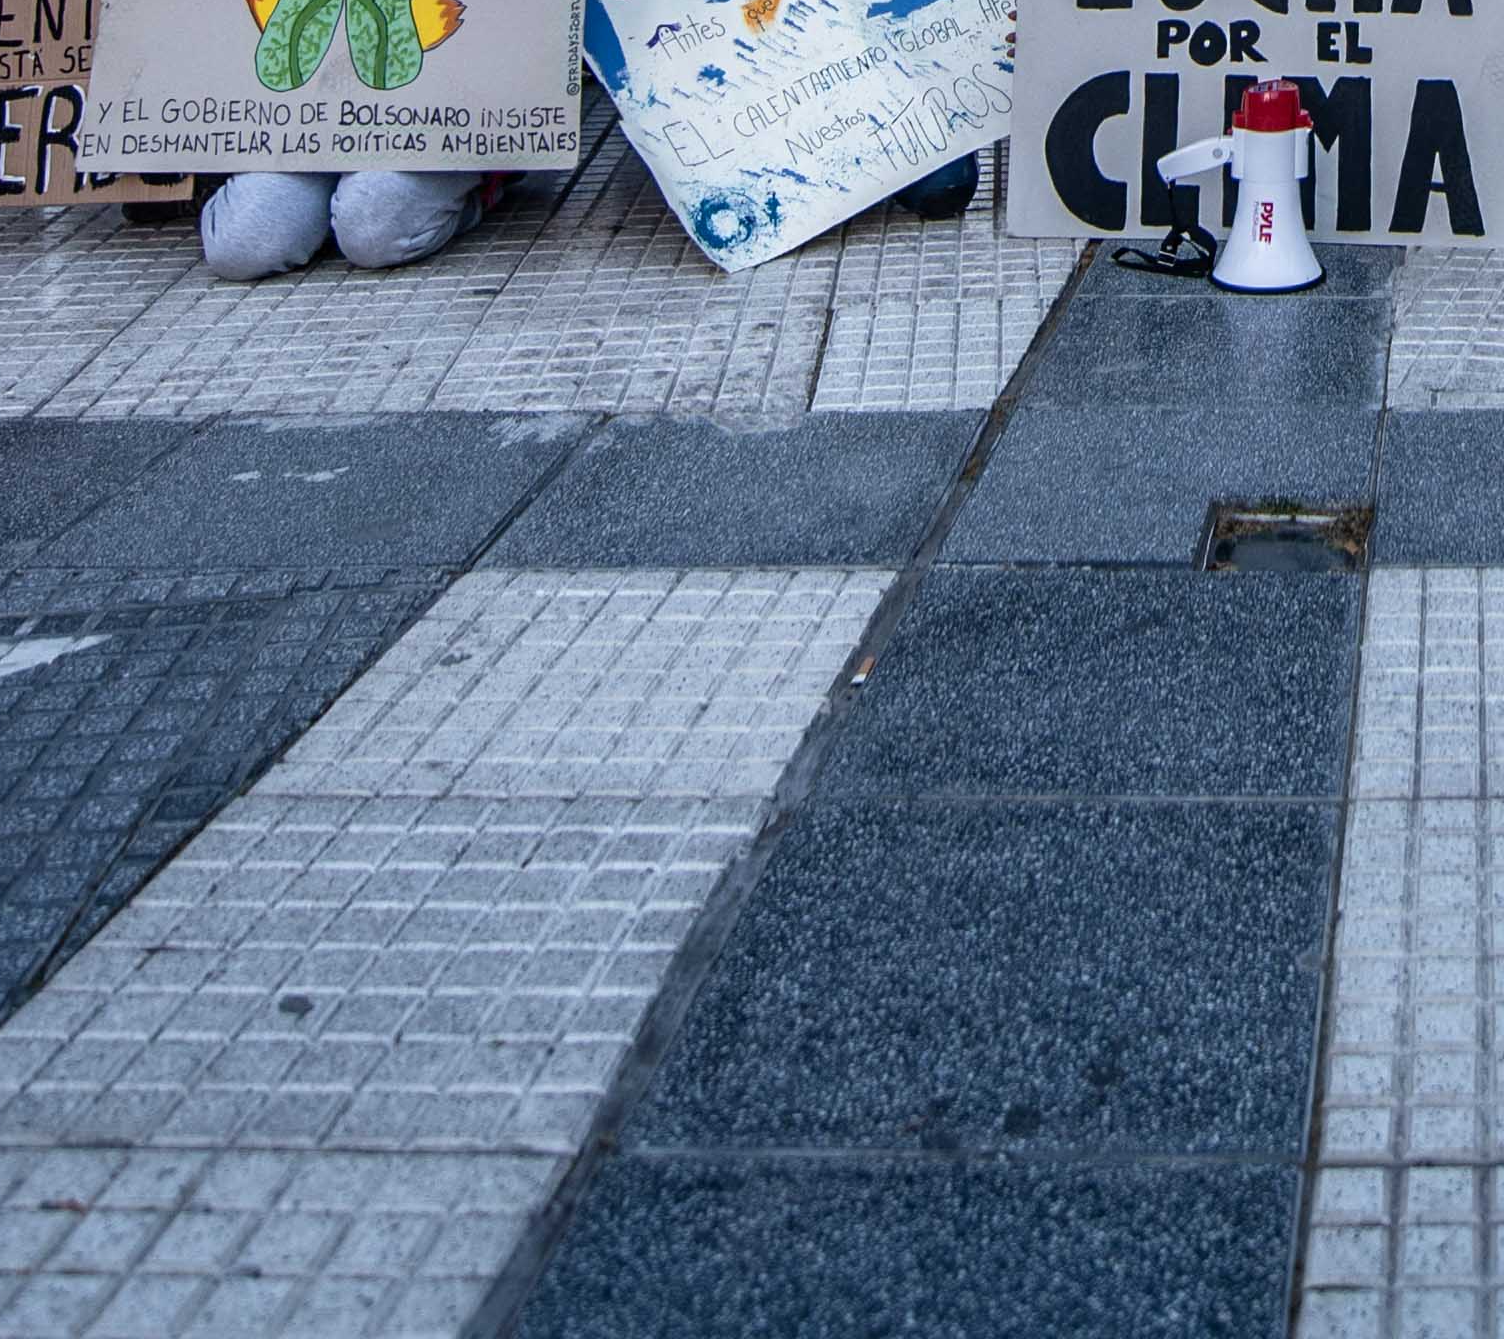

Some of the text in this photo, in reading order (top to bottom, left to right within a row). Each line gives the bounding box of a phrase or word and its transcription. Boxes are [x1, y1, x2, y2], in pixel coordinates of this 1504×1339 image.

[1156, 20, 1373, 66] POR EL
[122, 99, 472, 129] EL DE BOLSONARO
[81, 129, 321, 158] EN DESMANTELAR LAS
[665, 120, 737, 169] EL
[1259, 202, 1274, 245] PYLE
